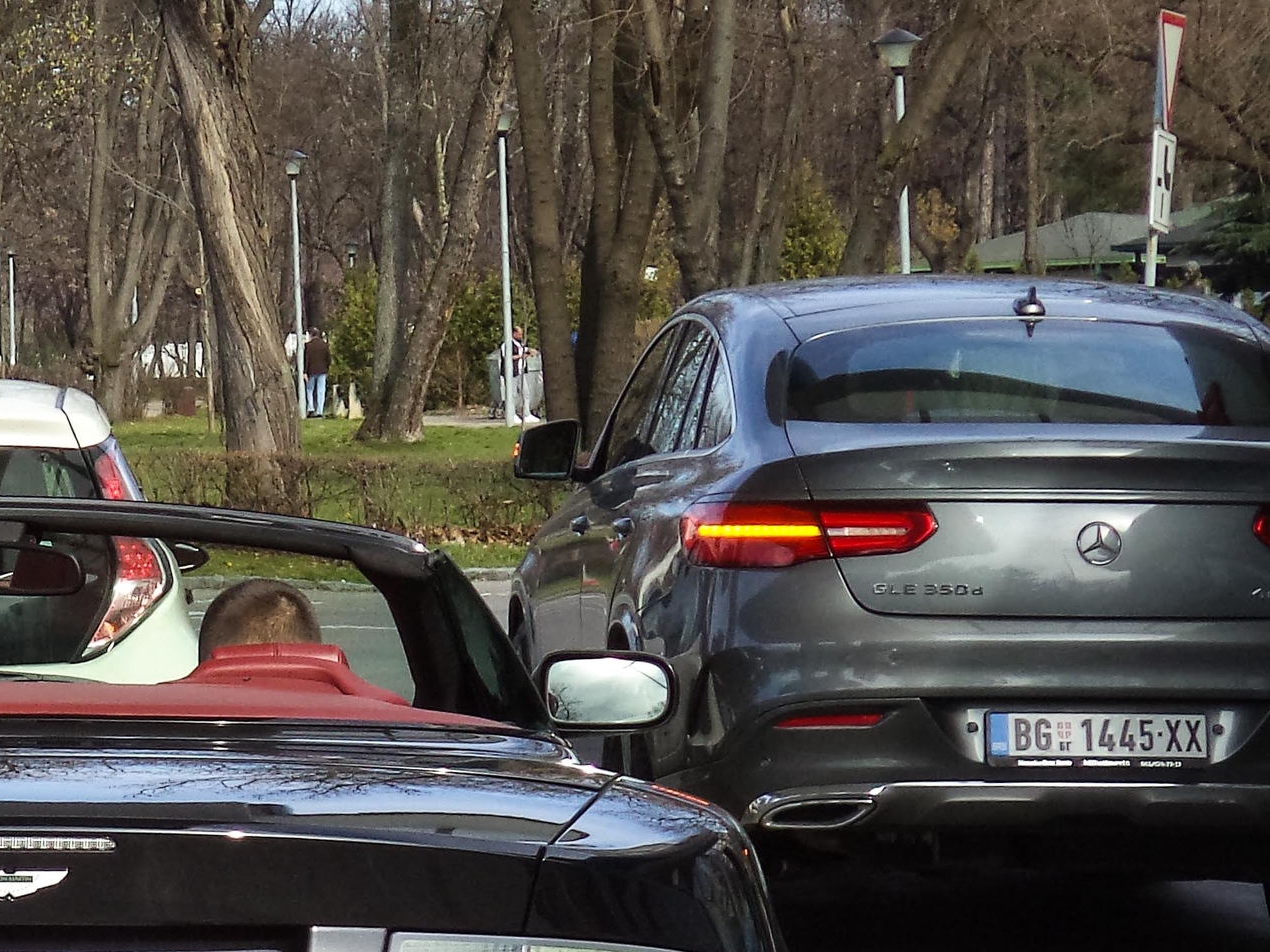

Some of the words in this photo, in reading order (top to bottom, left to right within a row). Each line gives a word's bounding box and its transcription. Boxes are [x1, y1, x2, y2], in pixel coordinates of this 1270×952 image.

[873, 583, 917, 595] GLE
[924, 583, 983, 596] 350d
[1014, 718, 1052, 751] BG
